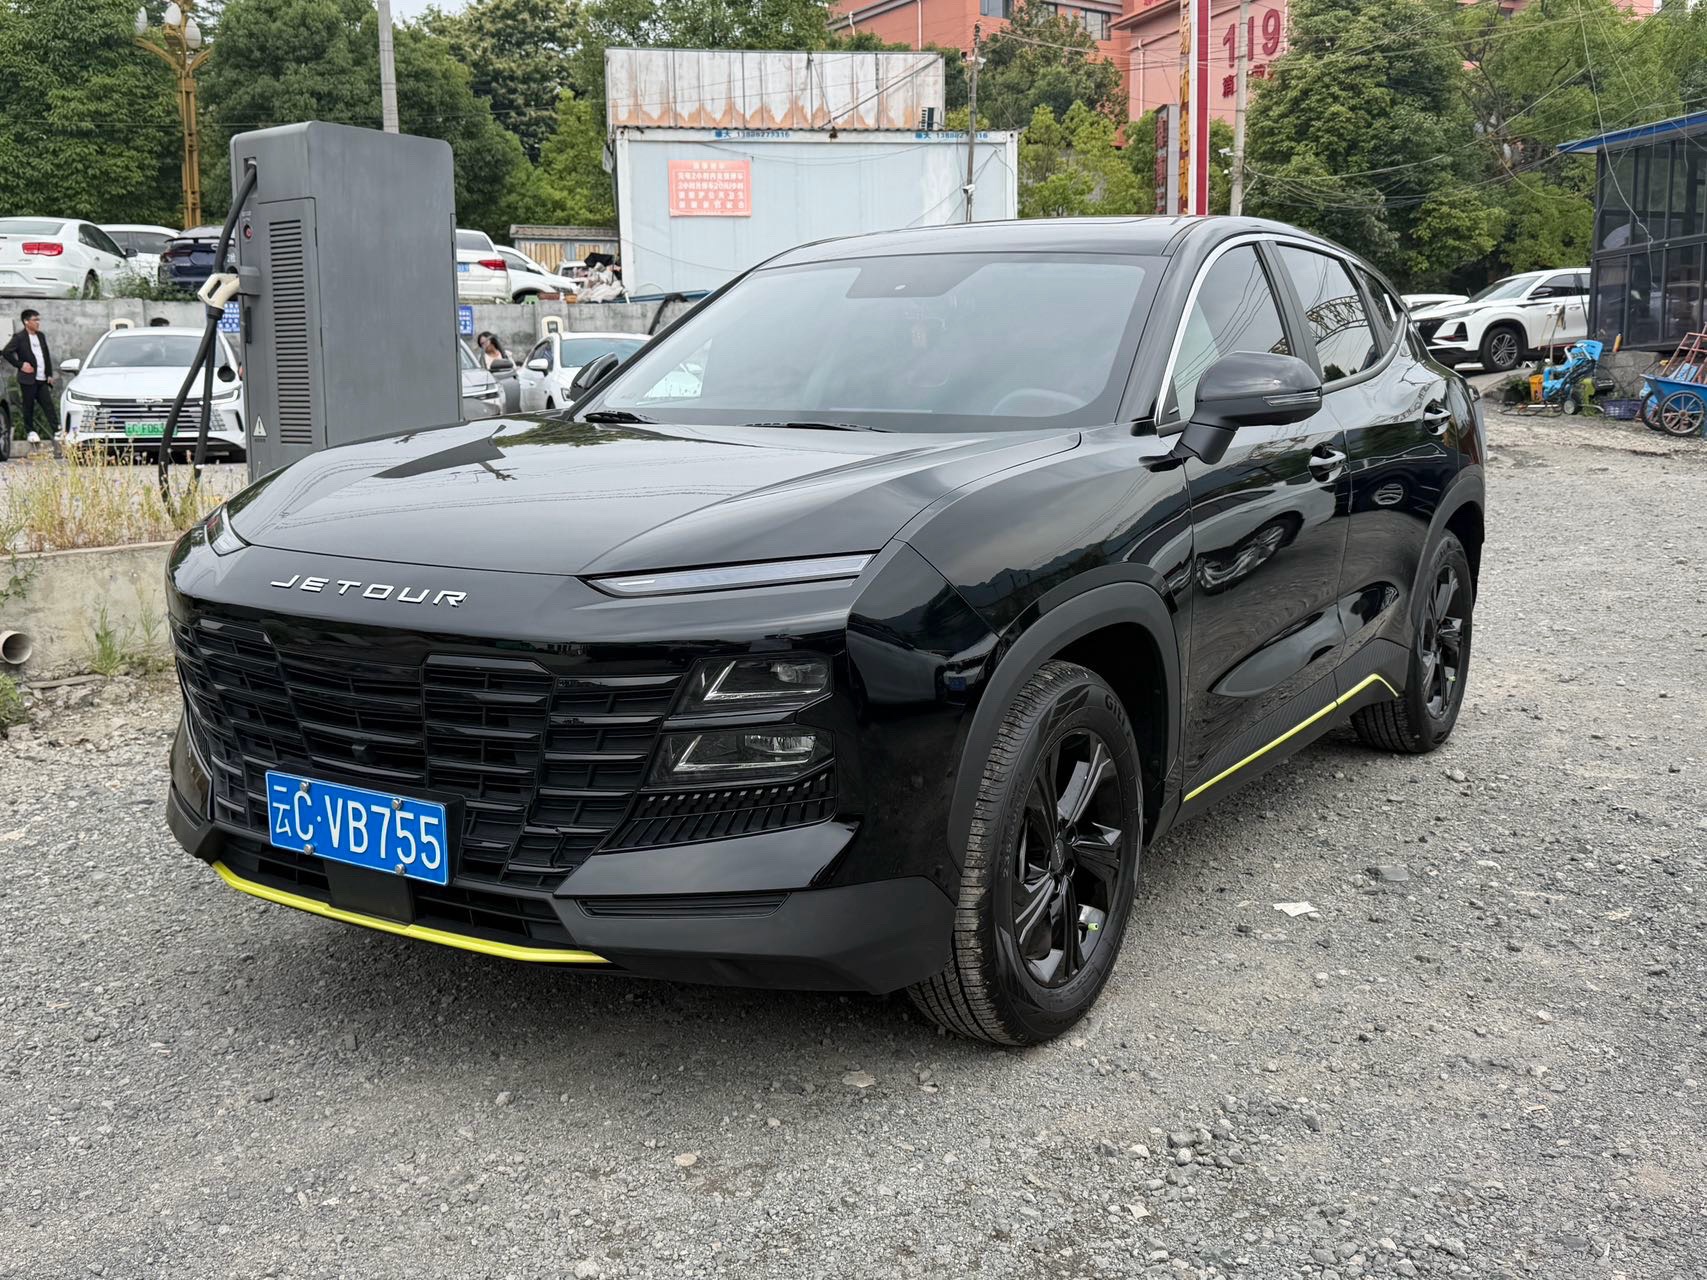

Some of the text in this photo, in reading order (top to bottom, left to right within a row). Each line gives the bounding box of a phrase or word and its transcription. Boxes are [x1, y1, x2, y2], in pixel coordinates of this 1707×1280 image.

[1223, 8, 1281, 68] 119
[270, 574, 469, 607] JETOUR
[272, 785, 441, 870] 云C·VB755
